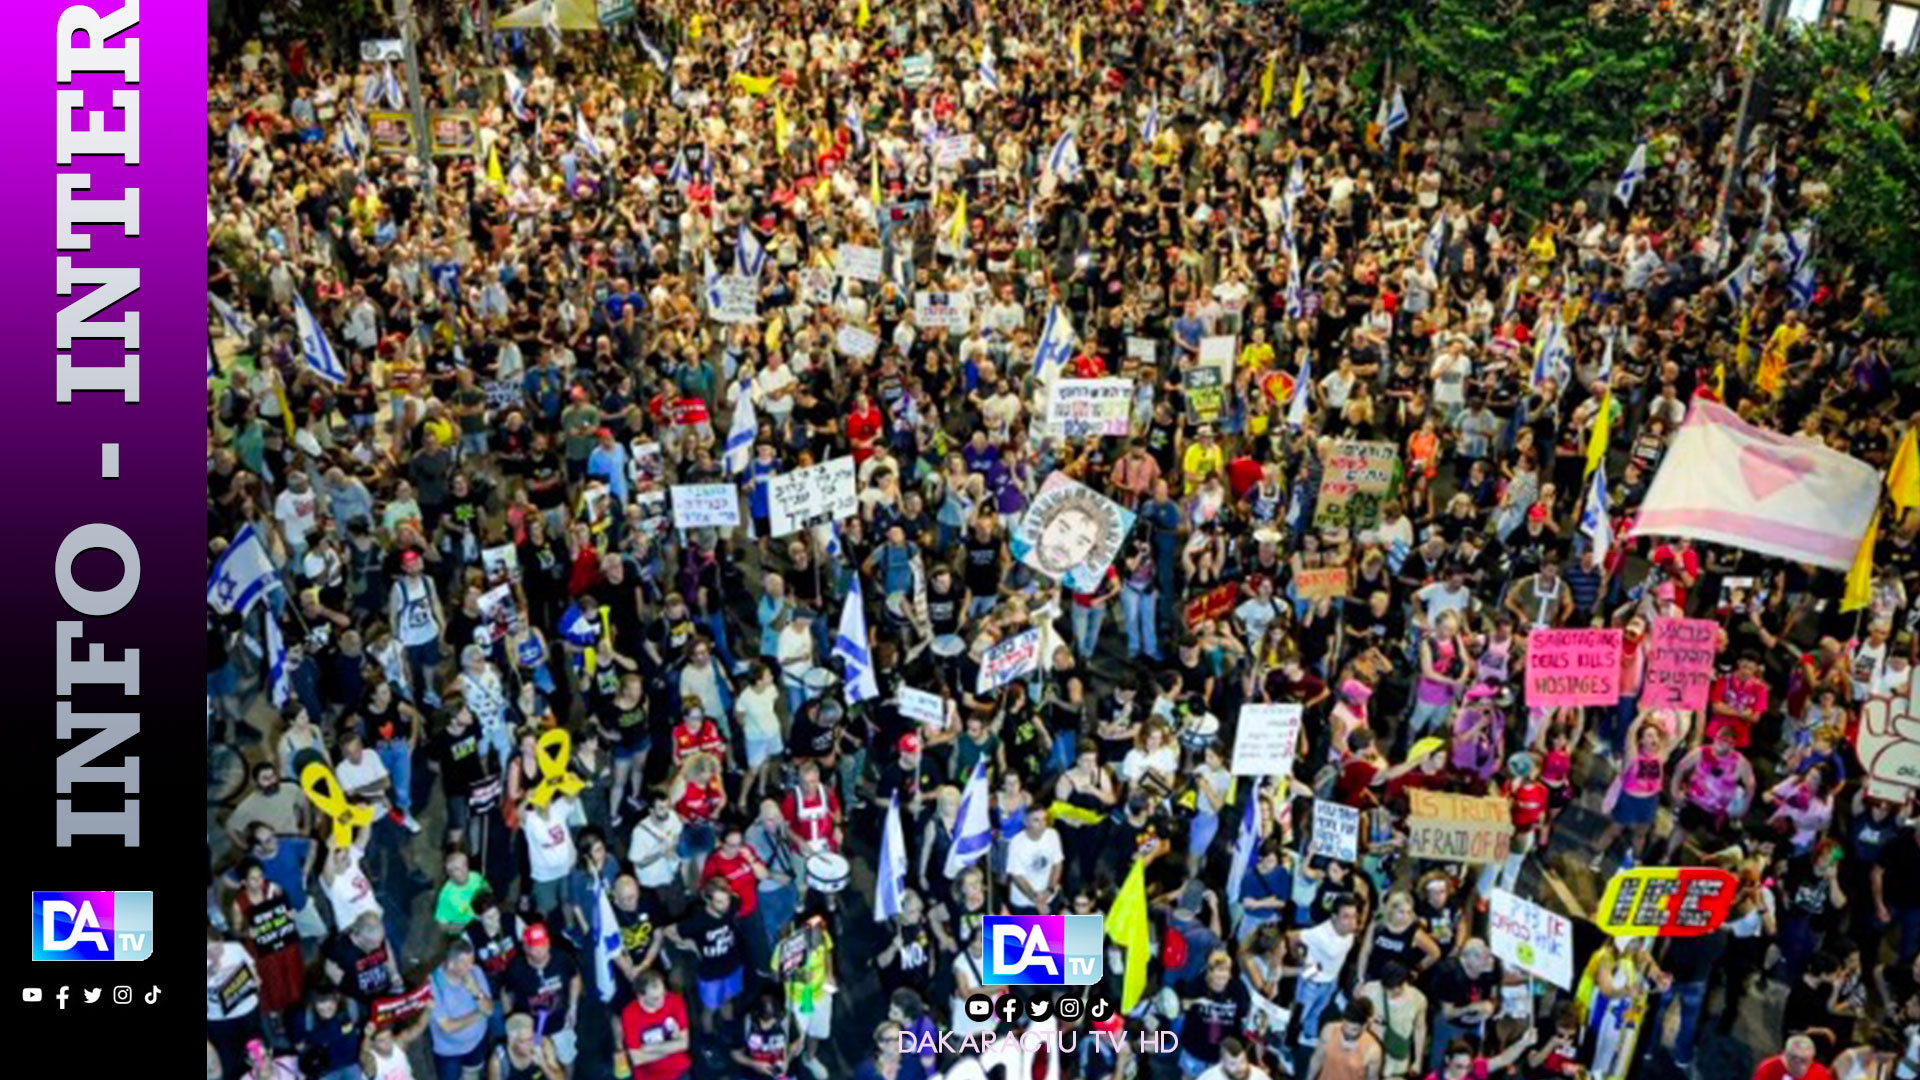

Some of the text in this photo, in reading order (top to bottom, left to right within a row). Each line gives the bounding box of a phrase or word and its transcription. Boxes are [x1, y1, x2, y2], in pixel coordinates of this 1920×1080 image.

[1533, 631, 1620, 648] SABOTAGING
[1532, 652, 1615, 668] DEALS KILLS
[1534, 675, 1611, 694] HOSTAGES
[1414, 792, 1439, 817] IS
[1408, 827, 1469, 856] AFRAID
[1471, 830, 1493, 858] OF
